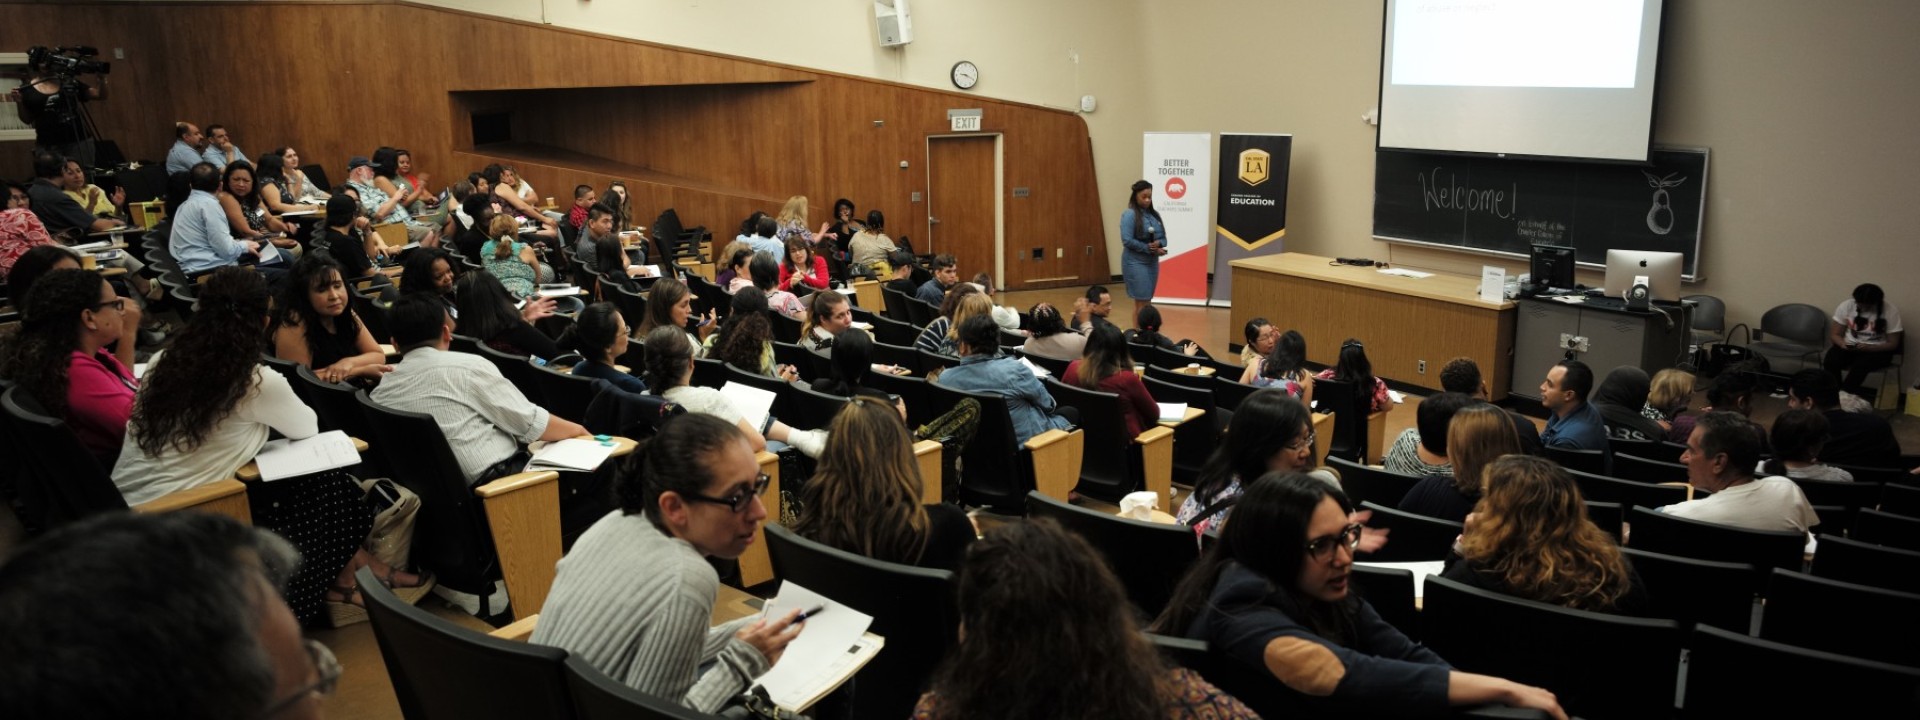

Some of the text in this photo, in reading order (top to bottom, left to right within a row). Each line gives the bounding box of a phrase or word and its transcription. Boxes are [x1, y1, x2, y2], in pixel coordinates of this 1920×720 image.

[955, 117, 977, 129] EXIT
[1164, 159, 1189, 167] BETTER
[1246, 162, 1263, 173] LA
[1158, 167, 1195, 176] TOGETHER
[1418, 166, 1517, 221] Welcome!
[1230, 197, 1275, 206] EDUCATION
